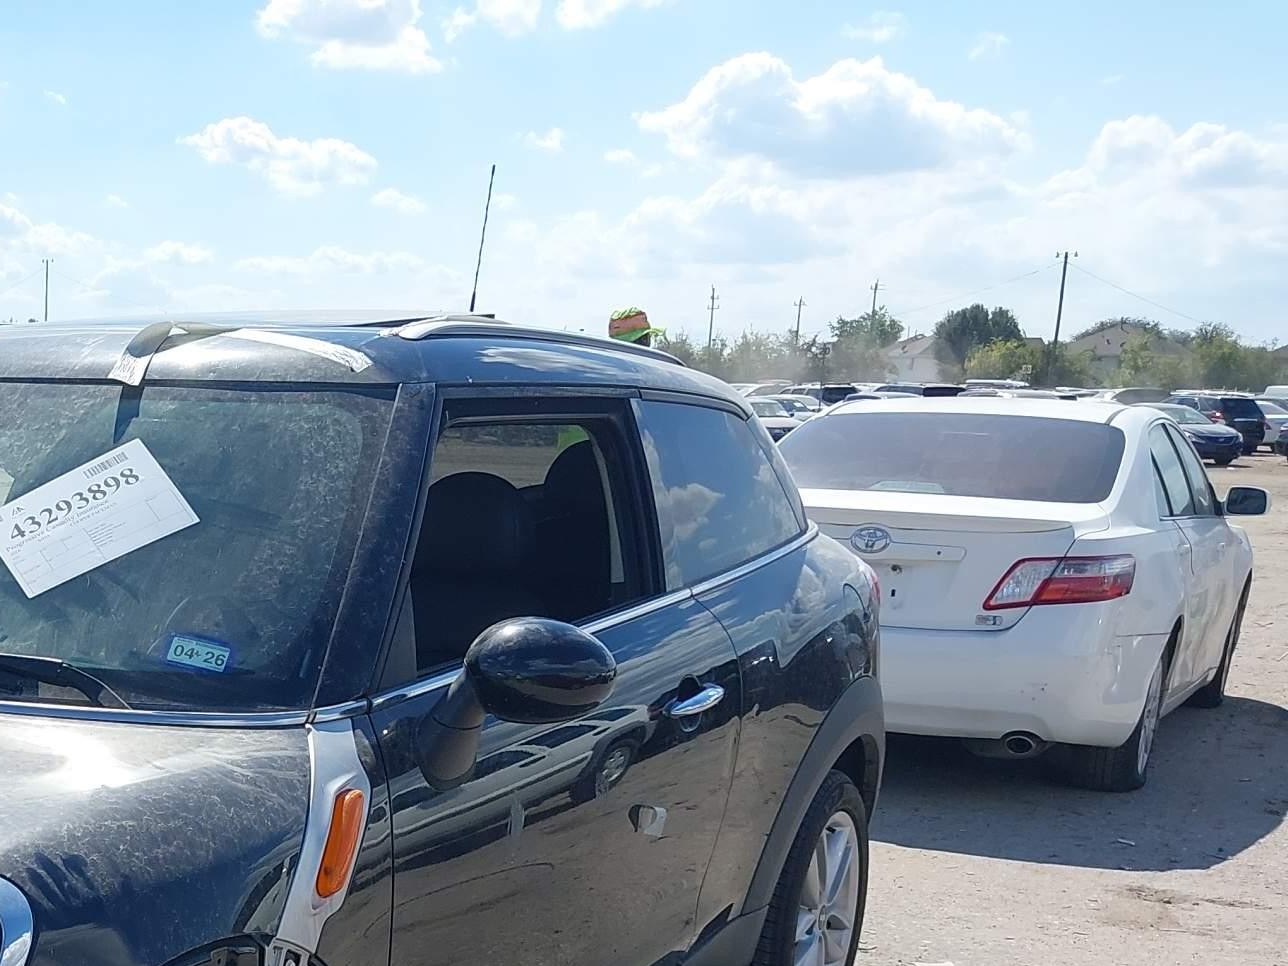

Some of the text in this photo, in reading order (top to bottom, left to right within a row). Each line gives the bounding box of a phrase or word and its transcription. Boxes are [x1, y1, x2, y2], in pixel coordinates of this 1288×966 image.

[10, 467, 139, 540] 43293898
[173, 644, 194, 660] 04
[203, 651, 226, 667] 26
